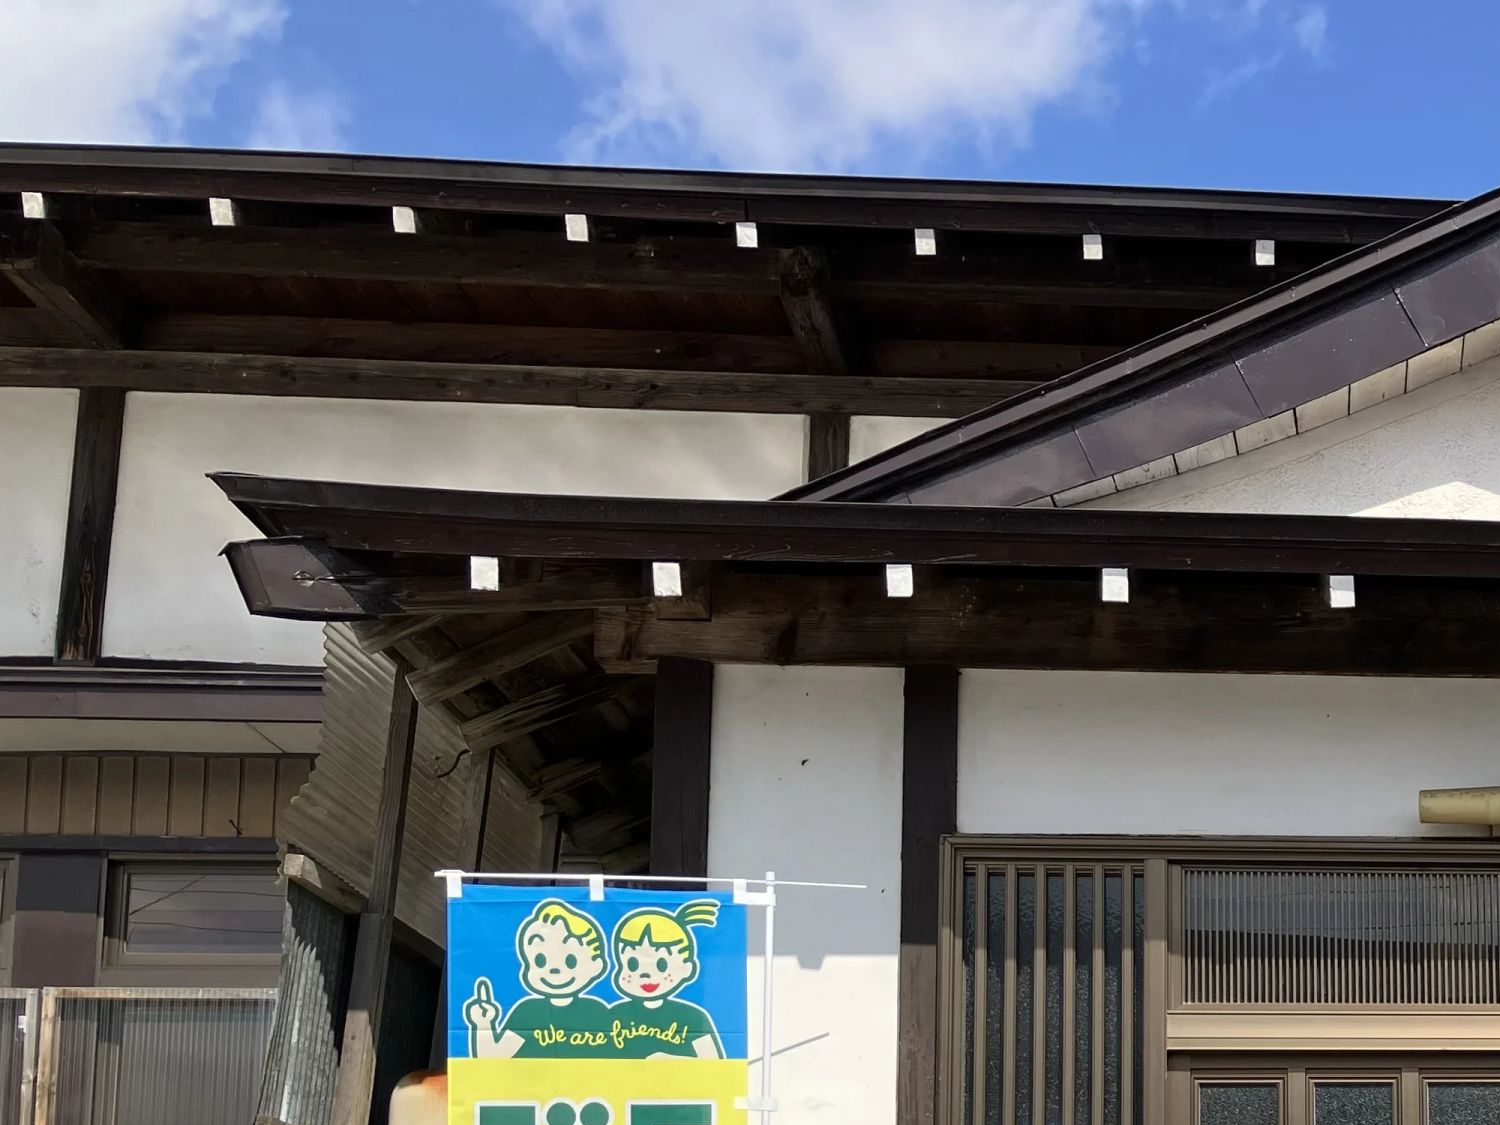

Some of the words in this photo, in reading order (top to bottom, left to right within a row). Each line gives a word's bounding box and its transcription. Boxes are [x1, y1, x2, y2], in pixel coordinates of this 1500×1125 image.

[534, 1025, 566, 1046] We
[571, 1032, 607, 1045] are
[610, 1020, 688, 1049] friends!
